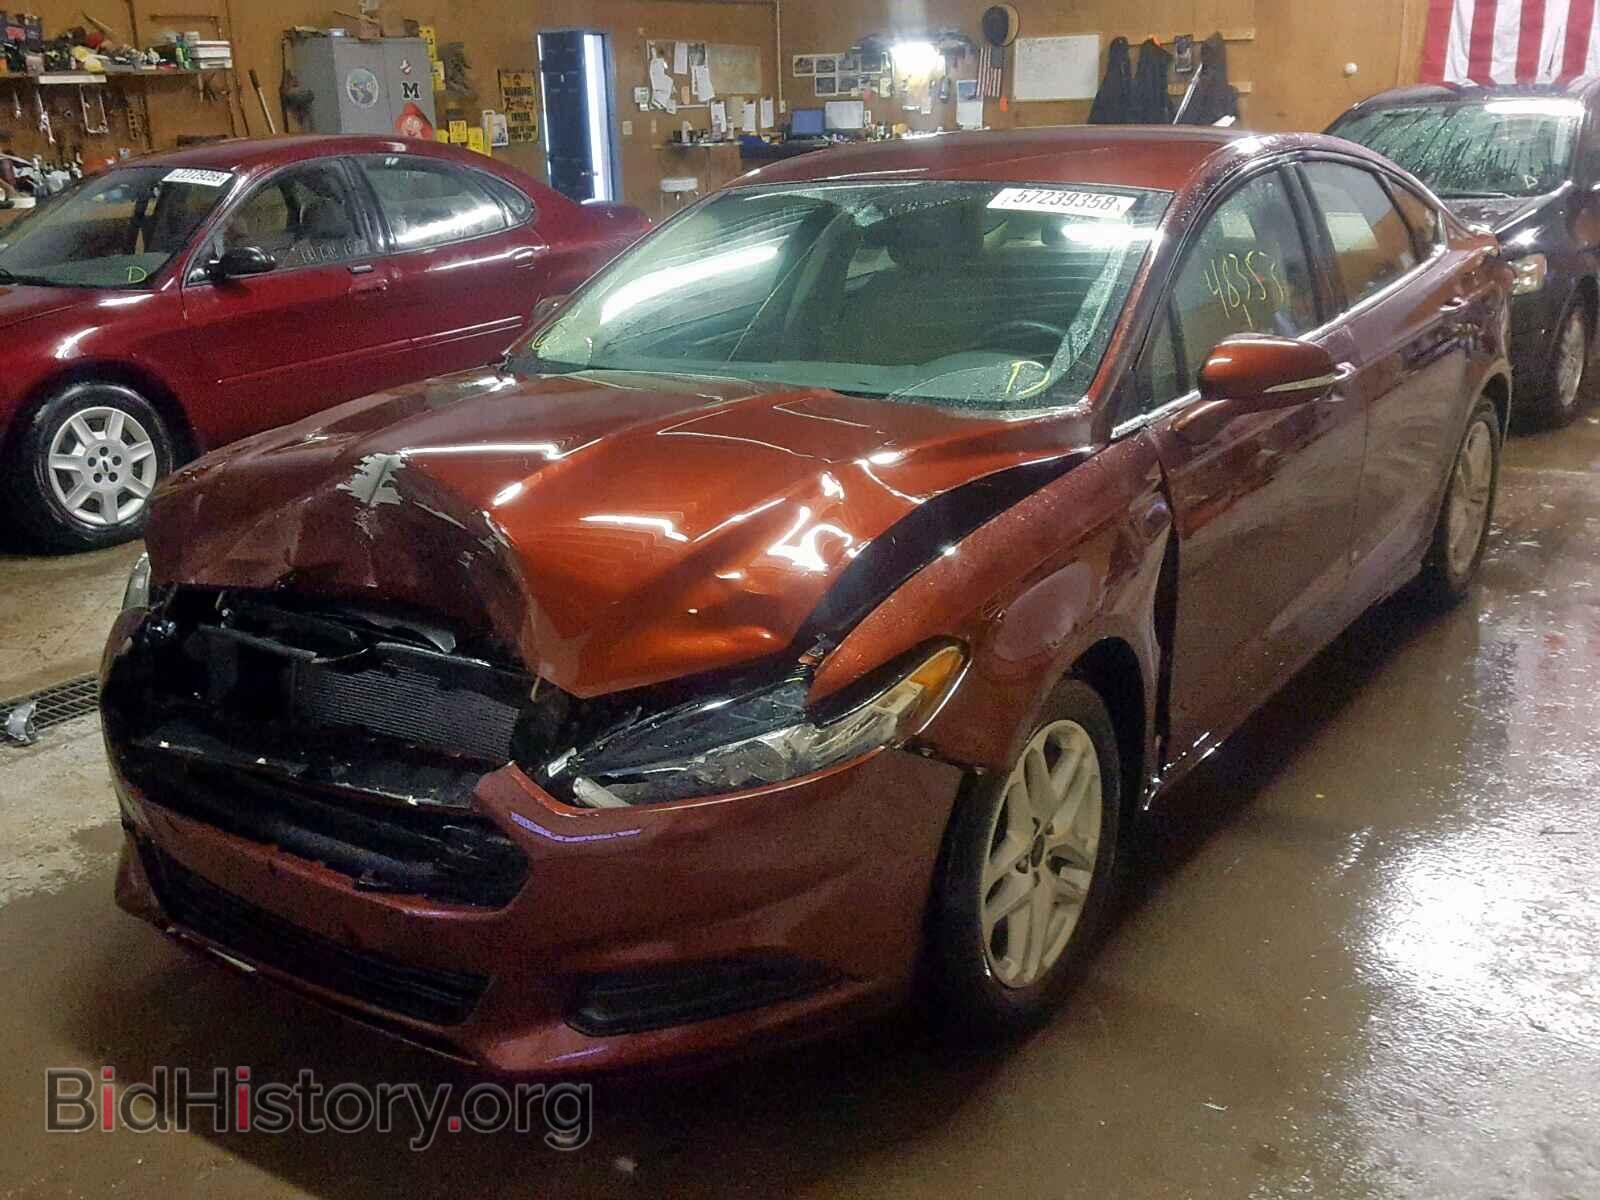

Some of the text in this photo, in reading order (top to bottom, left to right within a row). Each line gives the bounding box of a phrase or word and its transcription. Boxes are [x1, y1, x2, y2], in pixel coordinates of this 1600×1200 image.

[402, 82, 419, 98] M
[1013, 189, 1118, 210] 57239358
[127, 265, 149, 284] D
